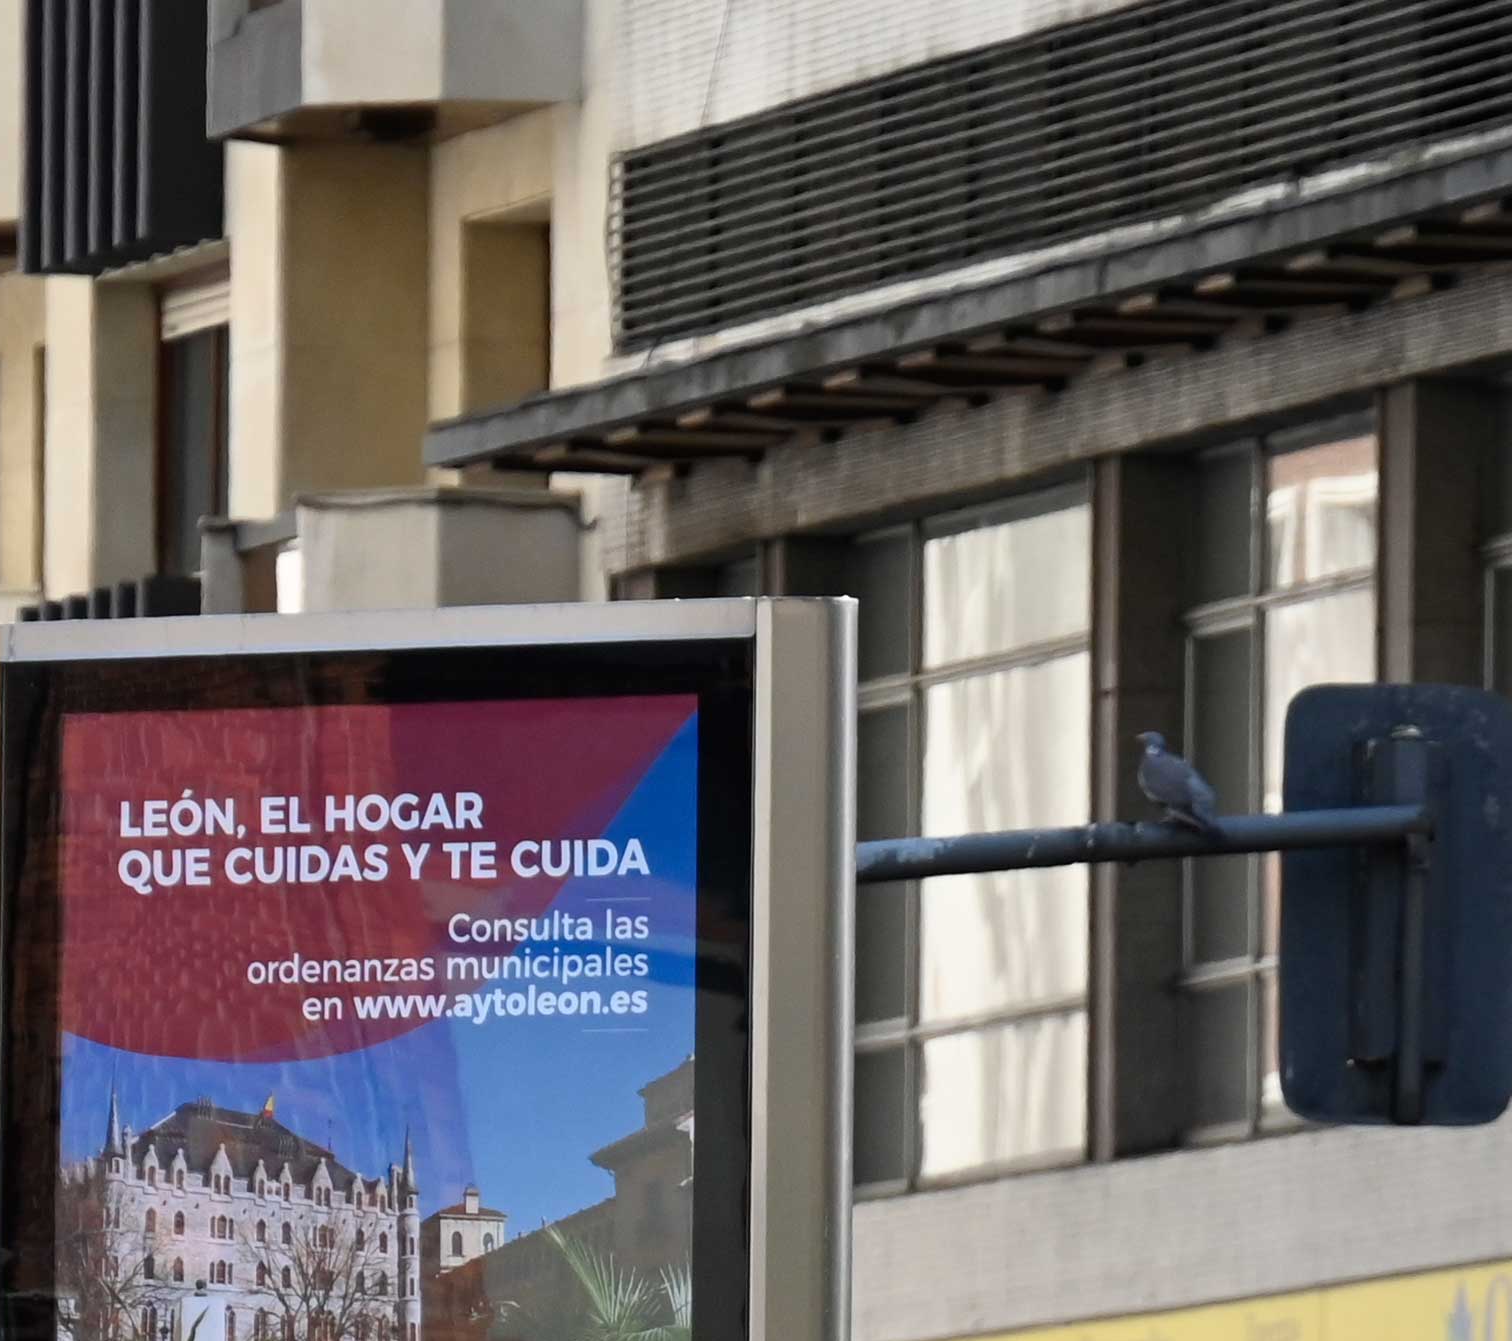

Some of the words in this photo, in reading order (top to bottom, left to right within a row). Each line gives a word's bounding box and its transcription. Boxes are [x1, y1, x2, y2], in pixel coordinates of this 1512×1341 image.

[119, 789, 245, 839] LEÓN,
[261, 796, 311, 834] EL
[325, 792, 484, 832] HOGAR
[117, 848, 211, 894] QUE
[224, 844, 388, 885] CUIDAS
[401, 843, 431, 879] Y
[442, 841, 497, 878] TE
[510, 838, 650, 877] CUIDA
[448, 910, 593, 942] Consulta
[606, 909, 649, 939] las
[247, 952, 435, 984] ordenanzas
[447, 947, 649, 984] municipales
[302, 996, 343, 1020] en
[354, 984, 648, 1024] www.aytoleon.es
